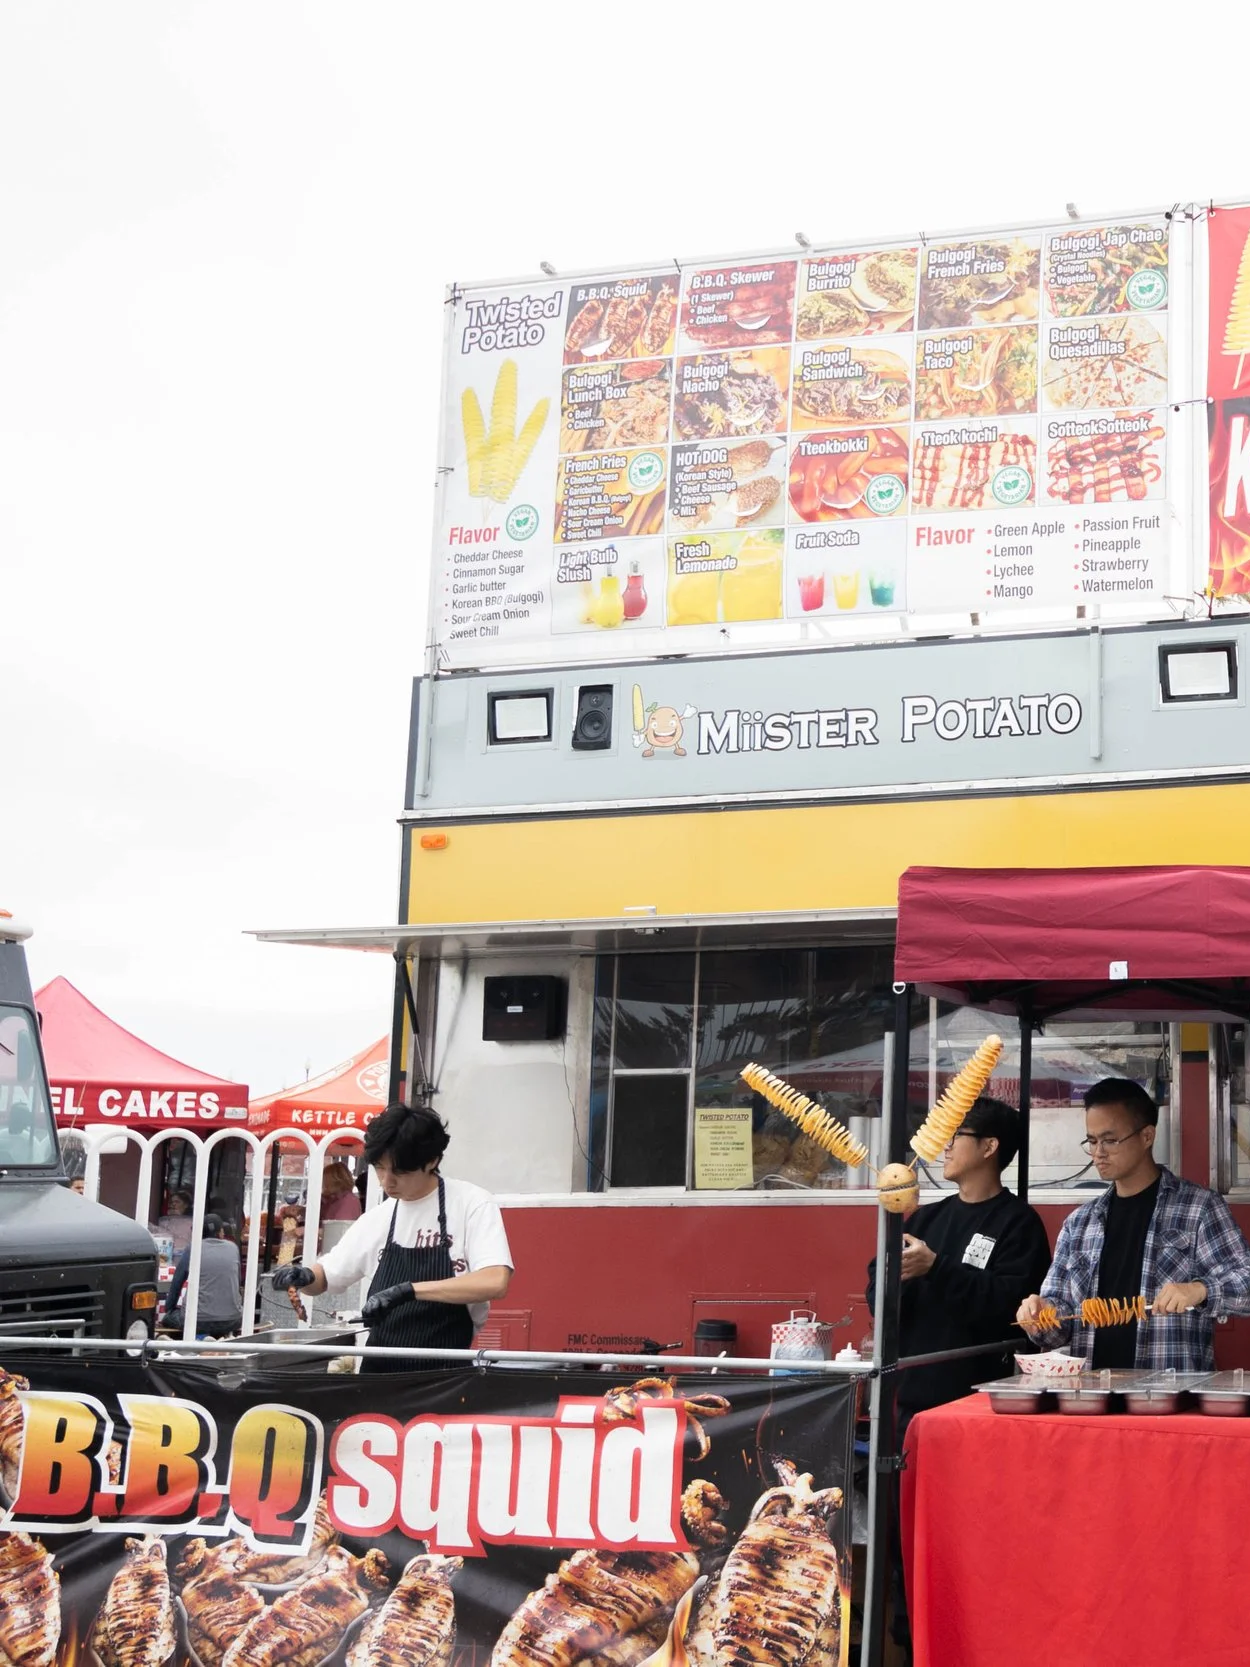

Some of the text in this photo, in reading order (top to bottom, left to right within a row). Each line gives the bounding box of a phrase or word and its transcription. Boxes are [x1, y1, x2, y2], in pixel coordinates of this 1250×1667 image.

[1050, 229, 1164, 252] Bulgogi Jap Chae
[928, 247, 976, 267] Bulgogi
[807, 260, 856, 278] Bulgogi
[926, 259, 1006, 280] French Fries
[1057, 263, 1088, 275] Bulgogi
[691, 269, 776, 290] B.B.Q. Skewer
[806, 276, 852, 292] Burrito
[1056, 273, 1097, 285] Vegetable
[576, 283, 648, 302] B.B.Q. Squid
[701, 289, 735, 304] Skewer)
[464, 291, 563, 328] Twisted
[697, 304, 715, 315] Beef
[695, 313, 728, 326] Chicken
[461, 319, 545, 354] Potato
[1049, 325, 1100, 345] Bulgogi
[924, 337, 974, 357] Bulgogi
[1048, 340, 1127, 360] Quesadillas
[802, 348, 851, 368] Bulgogi
[923, 355, 954, 371] Taco
[568, 372, 612, 389] Bulgogi
[683, 362, 729, 383] Bulgogi
[802, 364, 864, 381] Sandwich
[567, 385, 628, 404] Lunch Box
[682, 378, 720, 394] Nacho
[574, 409, 593, 420] Beef
[574, 417, 605, 430] Chicken
[1047, 416, 1151, 440] SotteokSotteok
[922, 426, 999, 448] Tteok kochi
[799, 438, 869, 457] Tteokbokki
[564, 455, 628, 475] French Fries
[675, 449, 728, 466] HOT DOG
[569, 475, 595, 486] Cheddar
[674, 467, 733, 483] (Korean Style)
[680, 480, 737, 496] Beef Sausage
[568, 497, 590, 507] Korean
[680, 493, 711, 507] Cheese
[567, 508, 588, 518] Nacho
[679, 506, 697, 518] Mix
[567, 515, 624, 529] Sour Cream Onion
[994, 521, 1065, 538] Green Apple
[1083, 515, 1161, 532] Passion Fruit
[449, 526, 501, 546] Flavor
[566, 530, 587, 540] Sweet
[795, 530, 860, 549] Fruit Soda
[915, 525, 976, 547] Flavor
[674, 543, 711, 558] Fresh
[994, 544, 1033, 558] Lemon
[1083, 537, 1142, 554] Pineapple
[453, 548, 524, 564] Cheddar Cheese
[558, 548, 618, 569] Light Bulb
[452, 563, 526, 579] Cinnamon Sugar
[557, 566, 592, 583] Slush
[674, 558, 738, 574] Lemonade
[994, 563, 1034, 580] Lychee
[1082, 557, 1150, 575] Strawberry
[452, 580, 506, 595] Garlic butter
[994, 584, 1034, 600] Mango
[1082, 577, 1154, 593] Watermelon
[451, 591, 544, 609] Korean BBQ (Bulgogi)
[451, 608, 530, 625] Sour Cream Onion
[449, 628, 477, 640] Sweet
[901, 693, 1083, 744] POTATO
[98, 1088, 220, 1119] CAKES
[291, 1109, 356, 1125] KETTLE
[725, 1113, 749, 1121] POTATO
[567, 1334, 588, 1345] FMC
[3, 1391, 693, 1556] B.B.Q squid
